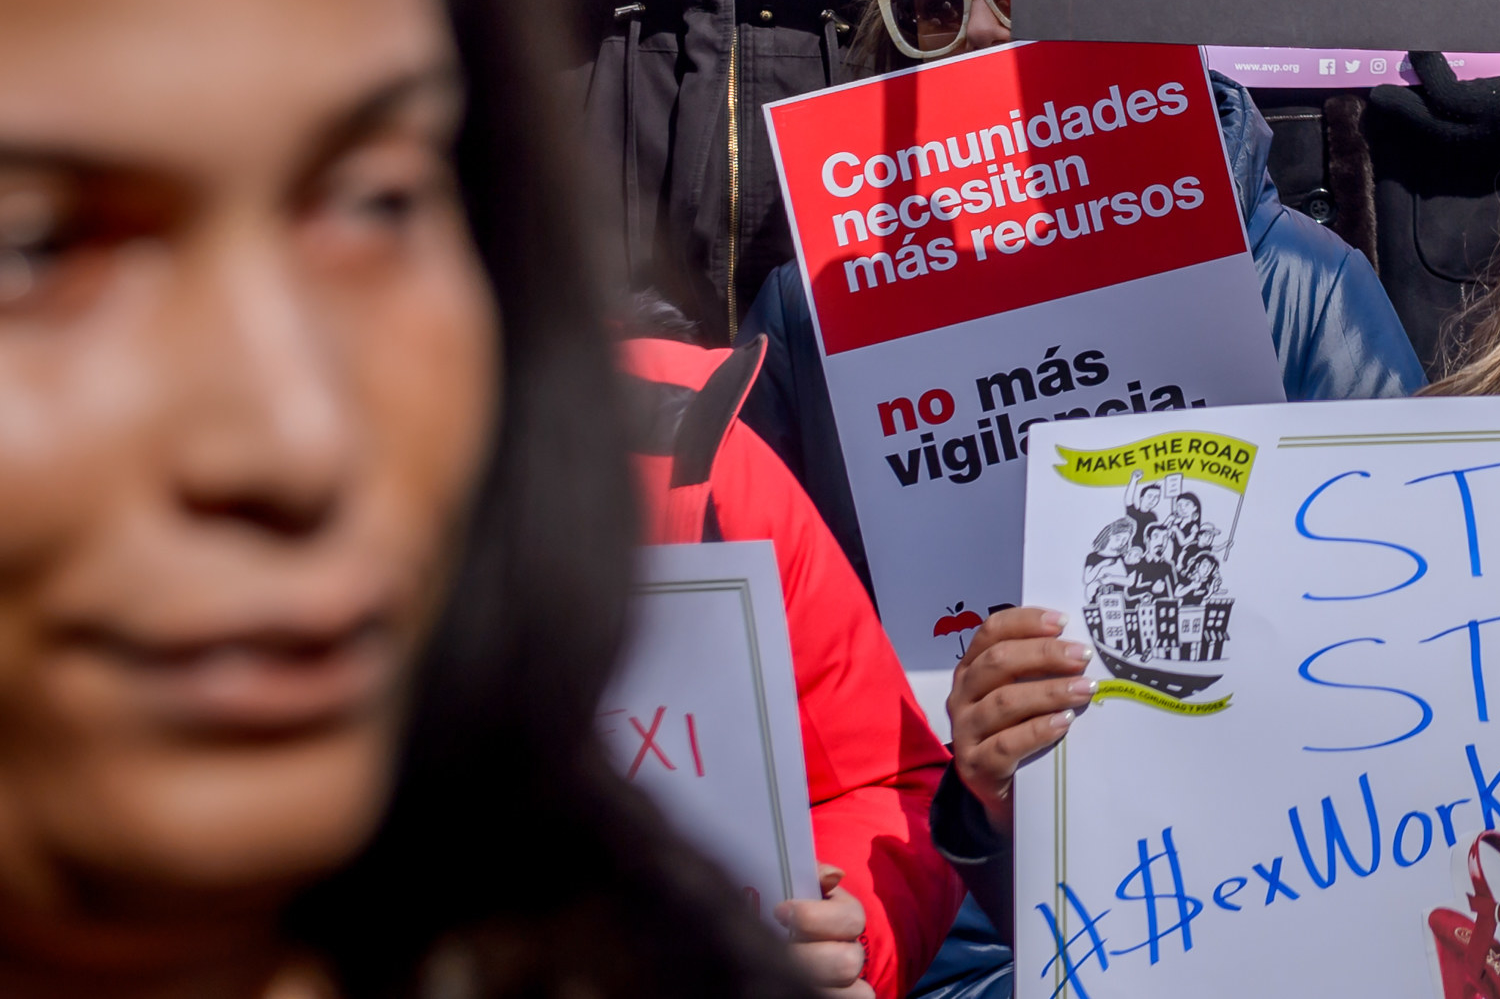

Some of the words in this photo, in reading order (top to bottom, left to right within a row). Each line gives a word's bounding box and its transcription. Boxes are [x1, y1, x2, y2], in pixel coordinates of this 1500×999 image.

[1234, 62, 1300, 74] www.avp.org
[821, 81, 1189, 199] Comunidades
[832, 154, 1090, 247] necesitan
[842, 232, 958, 293] más
[969, 175, 1204, 262] recursos
[876, 387, 956, 438] no
[975, 344, 1110, 413] más
[1074, 449, 1137, 473] MAKE
[1139, 437, 1183, 461] THE
[1188, 438, 1250, 465] ROAD
[1154, 457, 1195, 475] NEW
[1200, 459, 1245, 484] YORK
